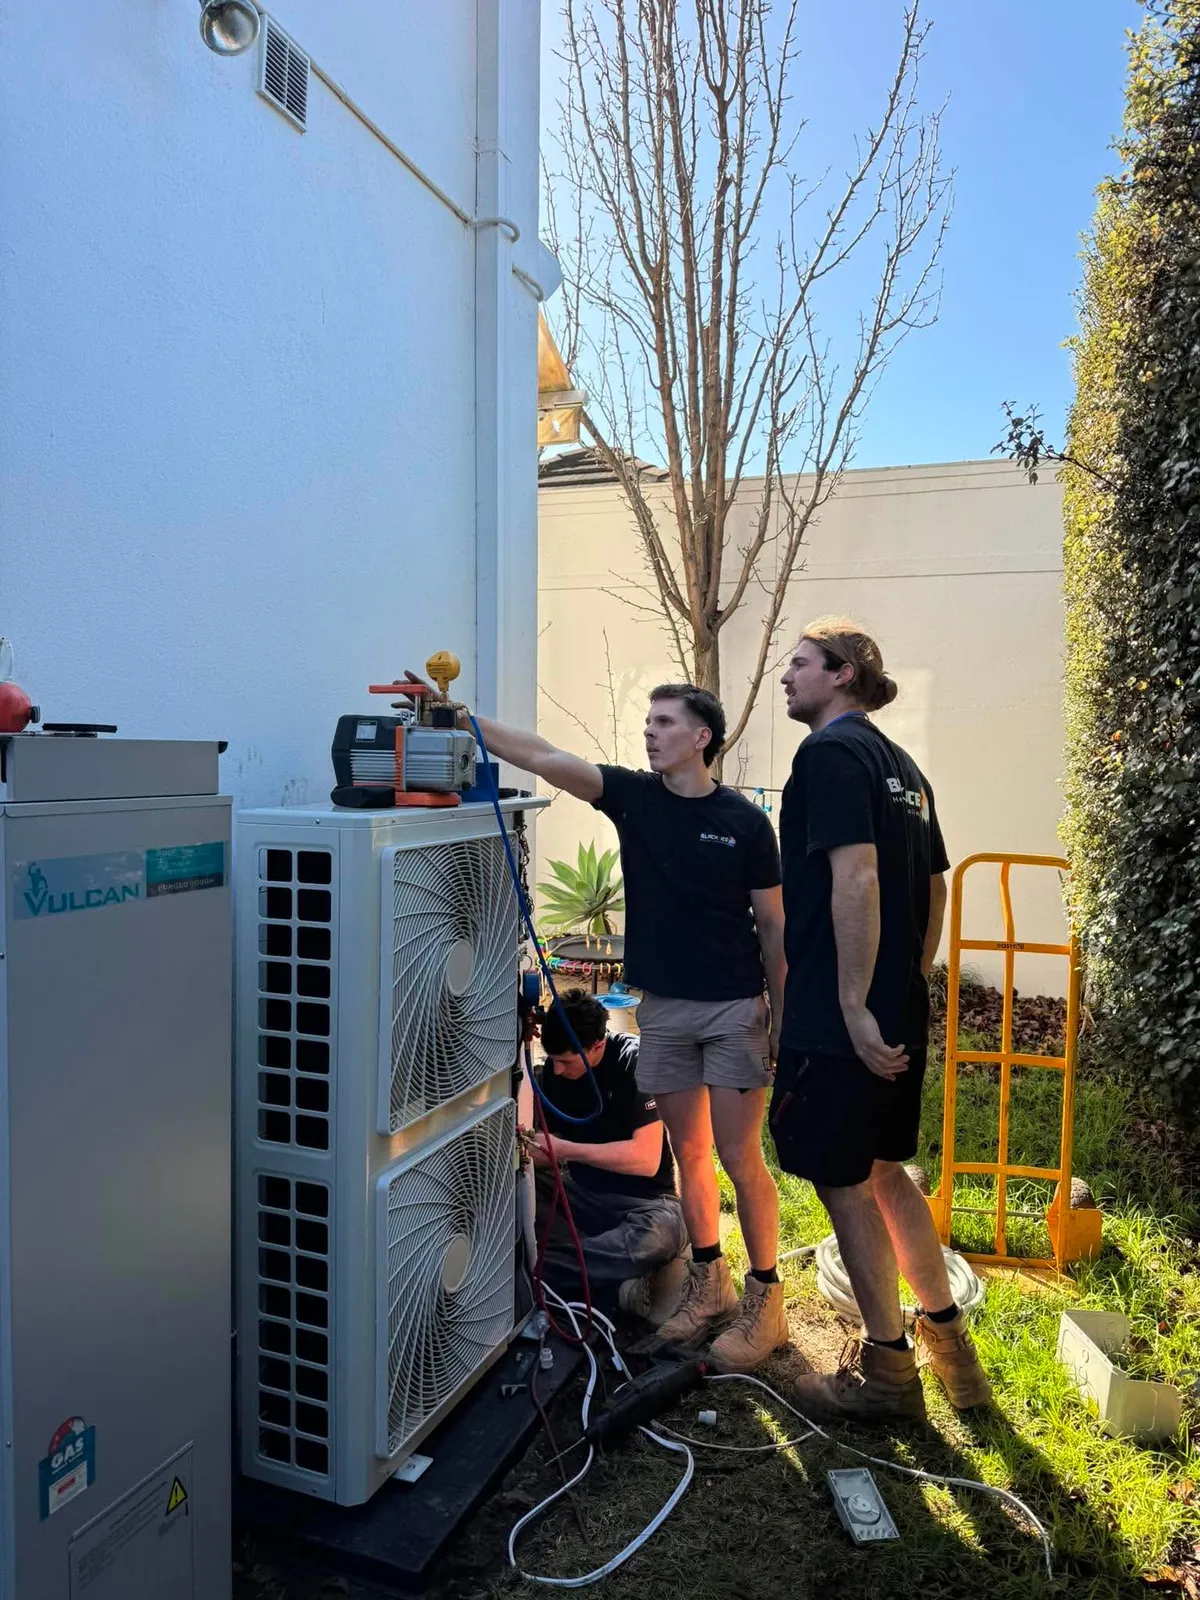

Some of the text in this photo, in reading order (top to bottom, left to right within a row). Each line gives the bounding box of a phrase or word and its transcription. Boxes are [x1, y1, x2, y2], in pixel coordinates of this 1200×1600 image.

[23, 883, 140, 916] VULCAN
[157, 881, 189, 892] FORGED
[51, 1437, 84, 1468] GAS
